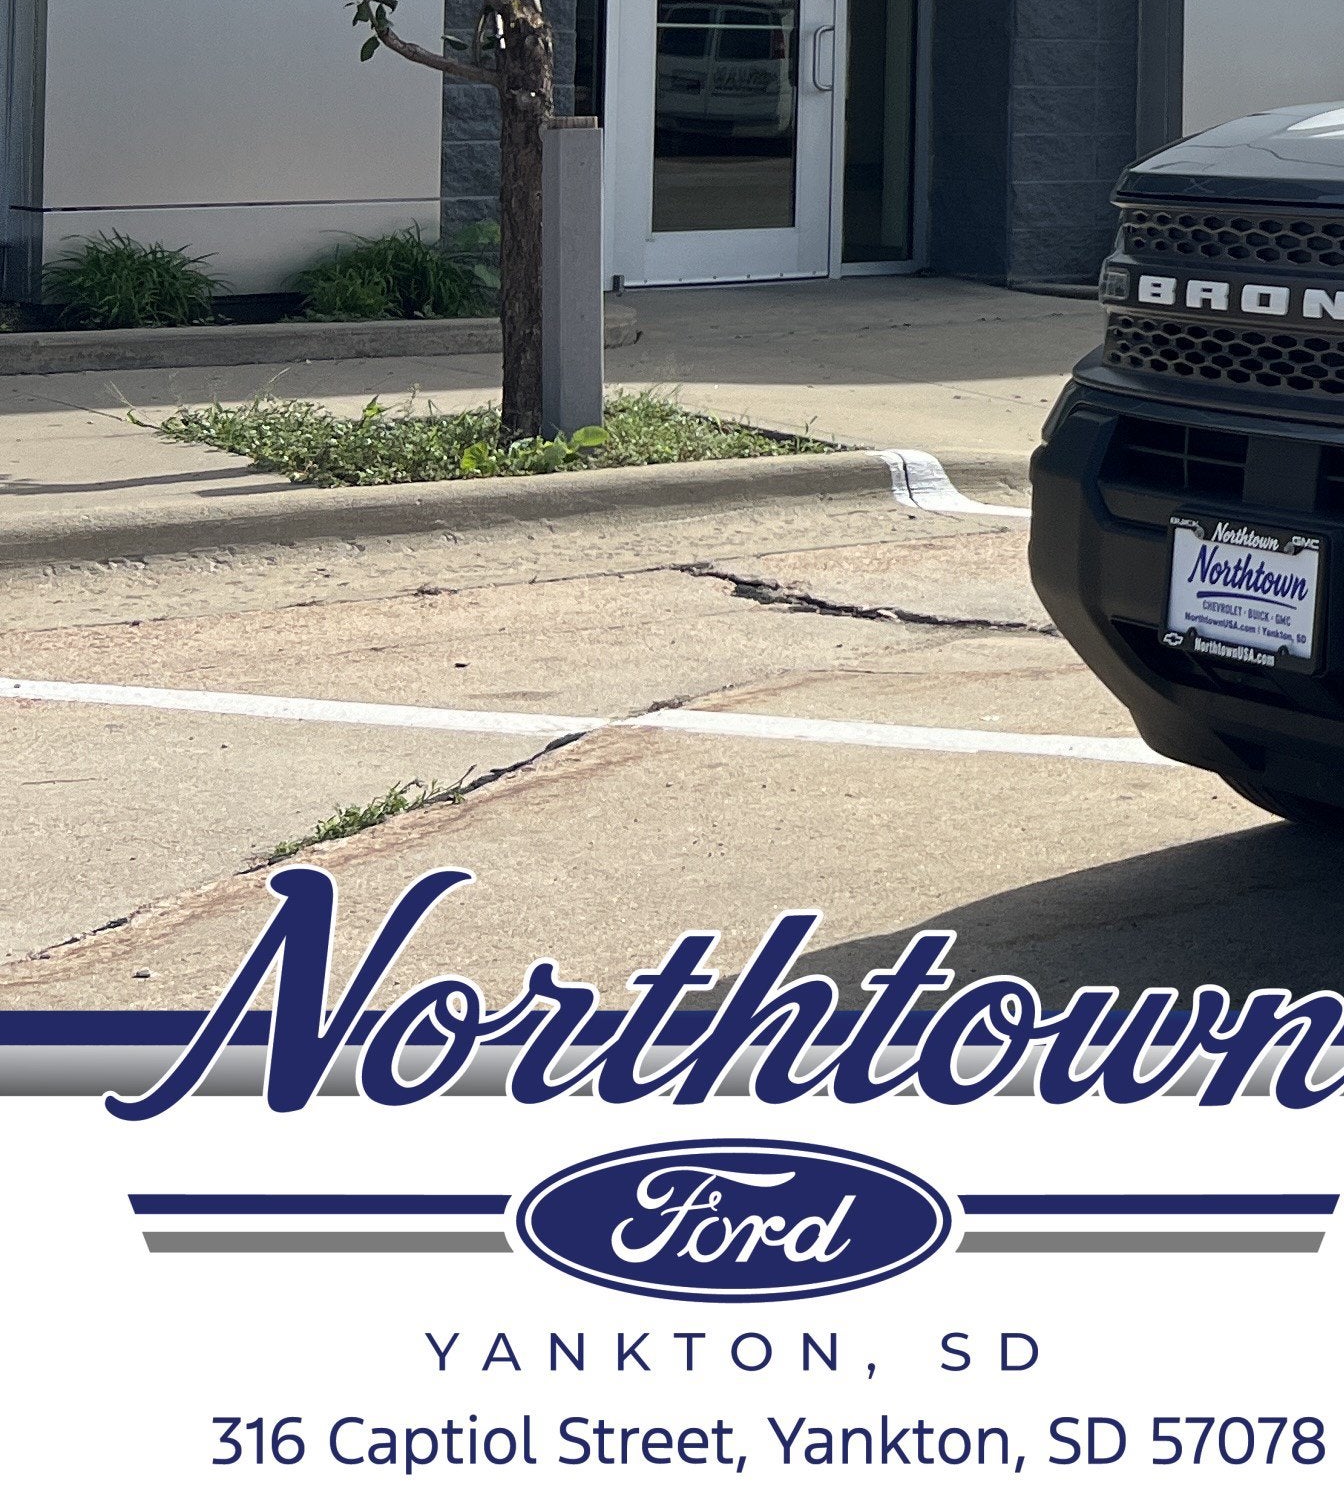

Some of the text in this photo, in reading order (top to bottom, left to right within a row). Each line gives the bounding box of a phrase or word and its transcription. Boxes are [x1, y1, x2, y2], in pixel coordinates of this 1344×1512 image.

[1211, 521, 1280, 551] Northtown
[1187, 544, 1309, 601] Northtown
[1202, 600, 1242, 616] CHEVROLET
[1194, 638, 1275, 667] NorthtownUSA.com
